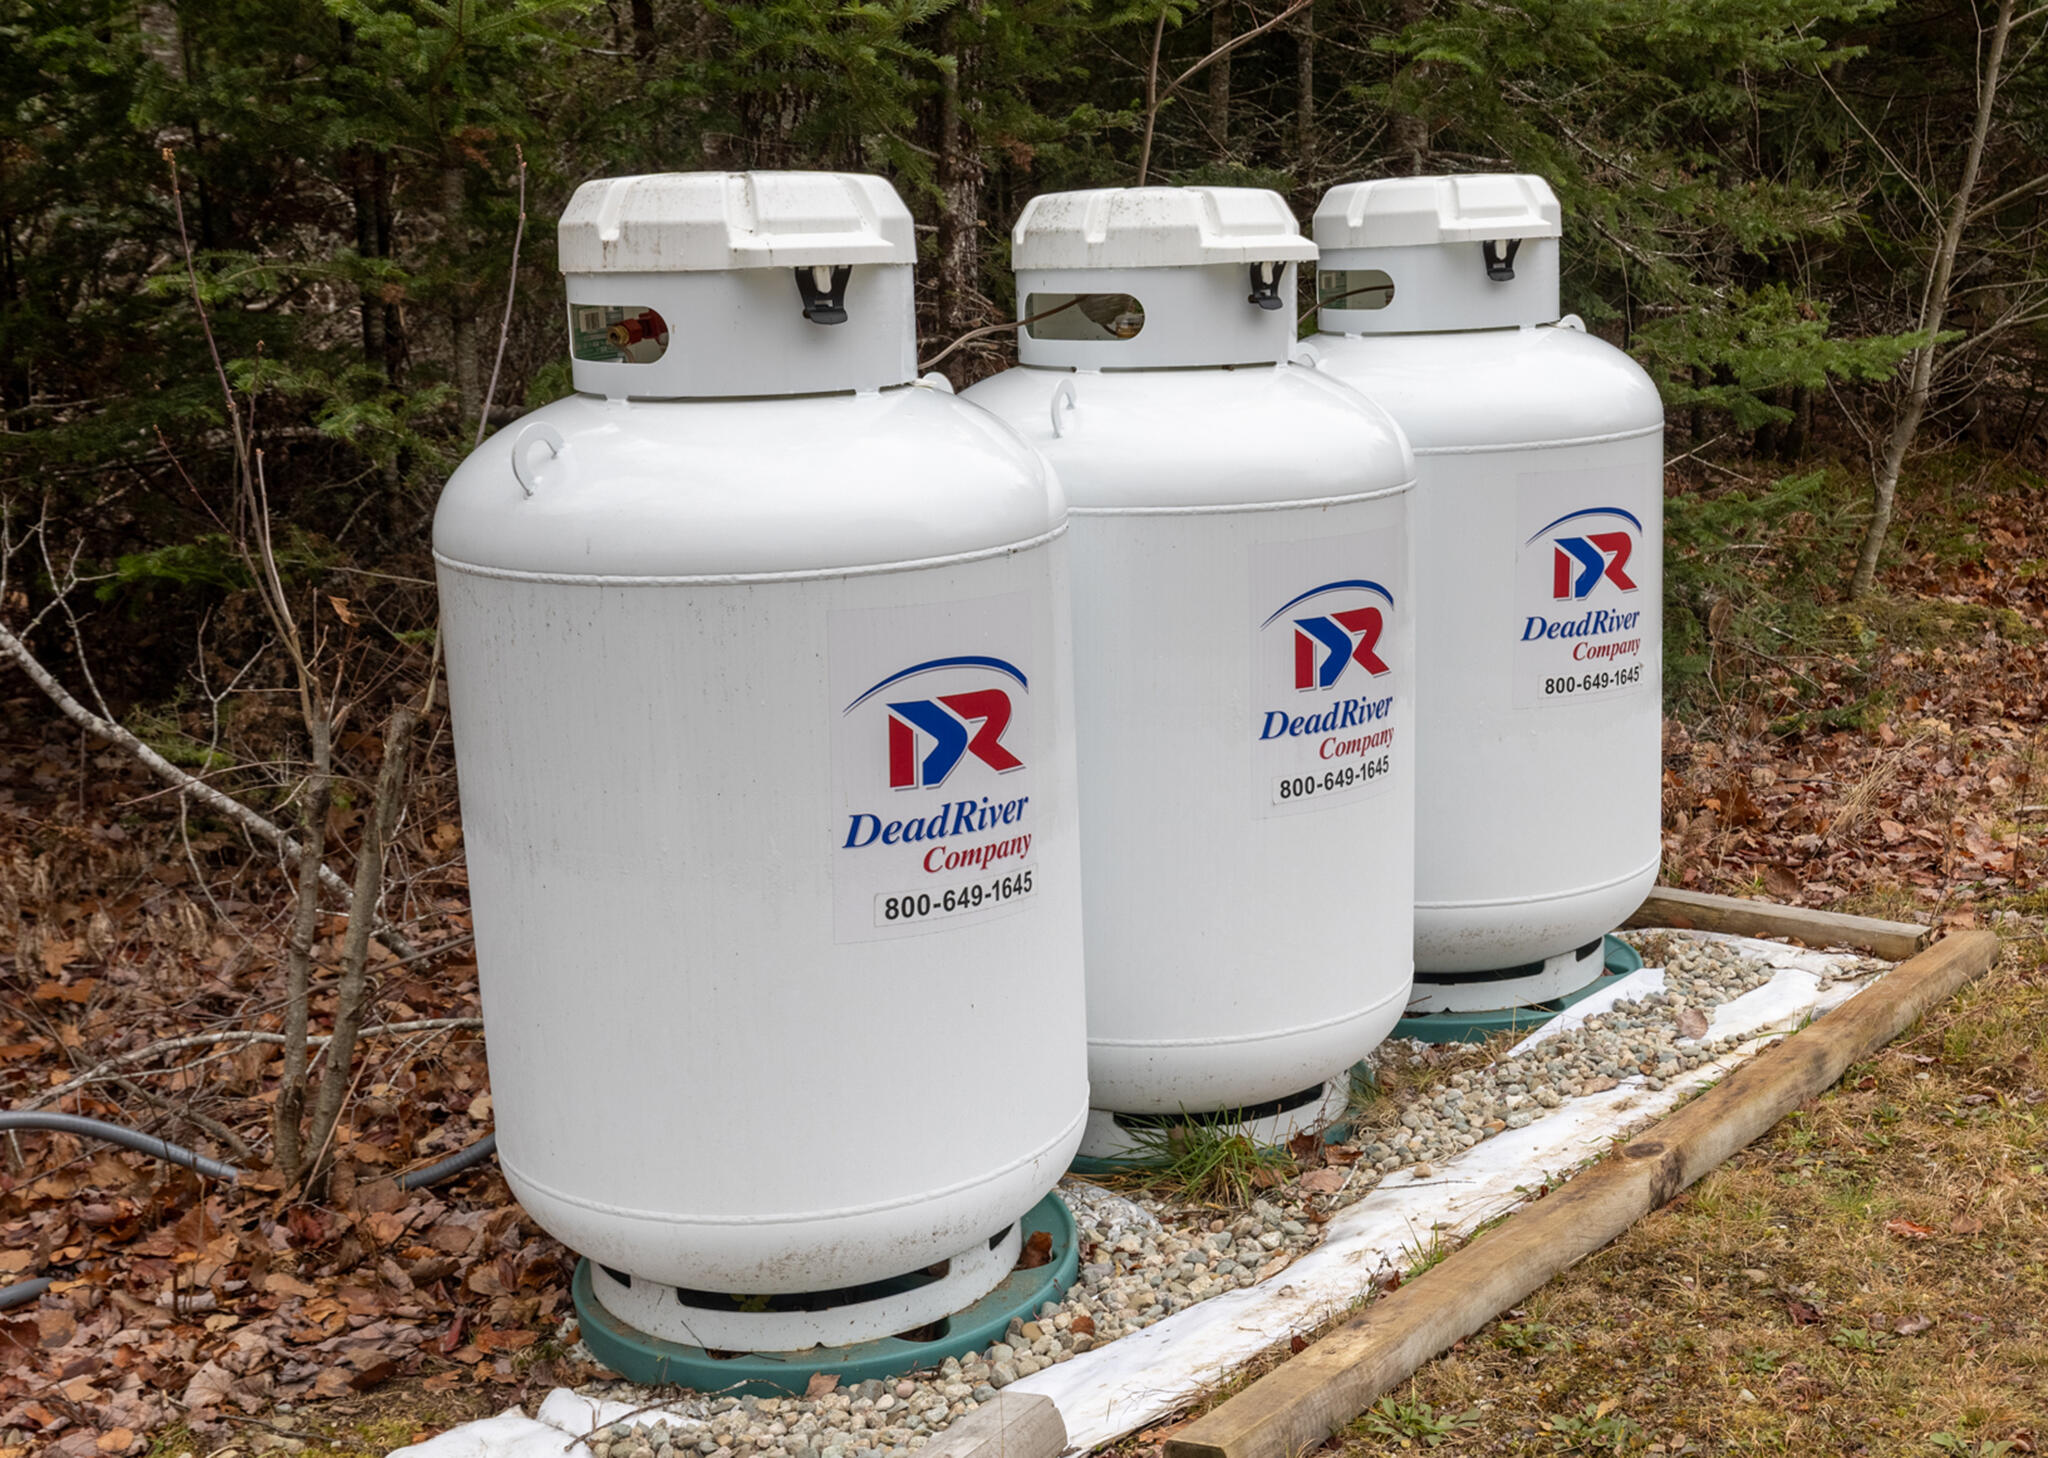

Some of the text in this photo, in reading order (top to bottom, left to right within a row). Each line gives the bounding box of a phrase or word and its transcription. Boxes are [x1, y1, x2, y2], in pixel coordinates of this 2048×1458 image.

[1572, 637, 1641, 661] Company
[1545, 665, 1640, 694] 800-649-1645
[1319, 727, 1394, 760] Company
[1279, 754, 1390, 799] 800-649-1645
[923, 833, 1032, 873] Company
[884, 870, 1033, 920] 800-649-1645
